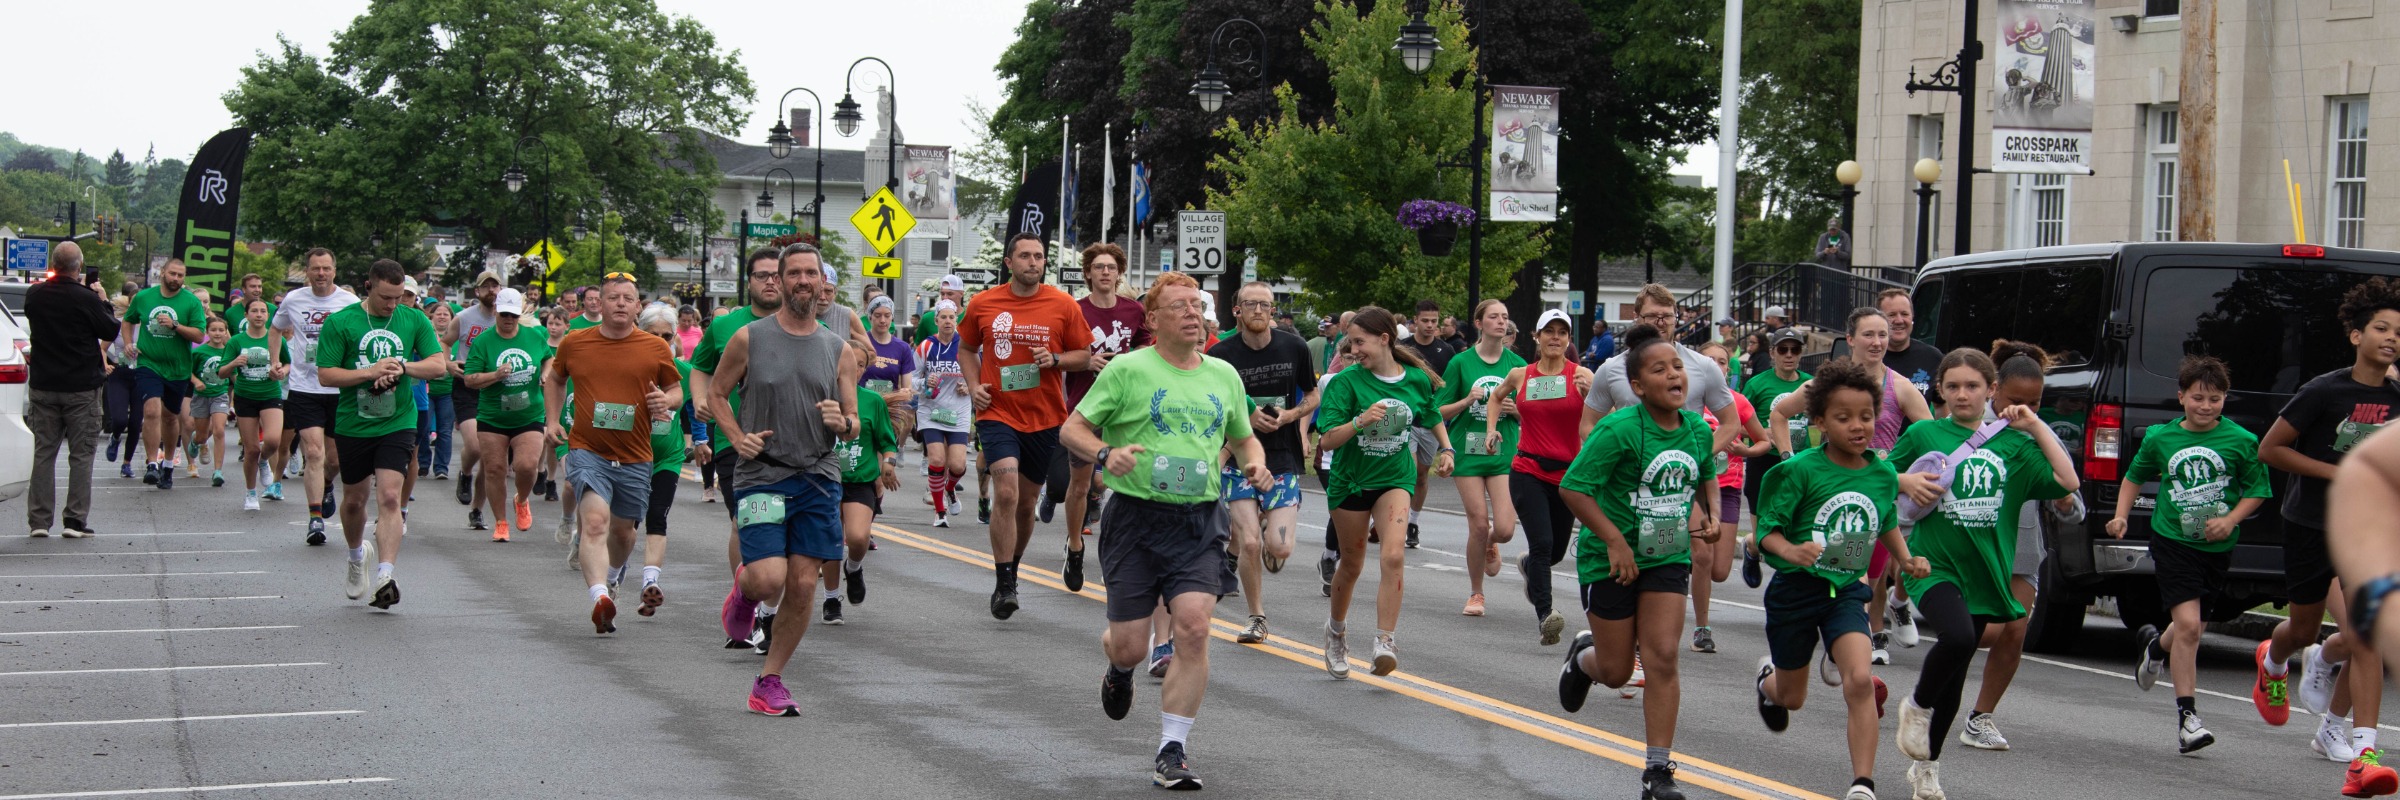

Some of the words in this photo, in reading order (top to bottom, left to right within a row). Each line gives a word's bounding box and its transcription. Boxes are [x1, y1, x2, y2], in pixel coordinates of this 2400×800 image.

[1501, 92, 1552, 105] NEWARK
[2005, 136, 2078, 152] CROSSPARK
[909, 149, 944, 158] NEWARK
[2002, 152, 2029, 161] FAMILY
[2031, 153, 2080, 163] RESTAURANT
[1507, 203, 1528, 213] Apple
[753, 225, 778, 236] Maple
[1184, 247, 1222, 269] 30
[185, 219, 231, 312] ART
[361, 331, 377, 349] LAUREL
[377, 330, 397, 340] HOUSE
[926, 361, 960, 370] BUFFA
[1249, 362, 1292, 375] EASTON
[1271, 370, 1293, 378] JACKET
[1535, 380, 1556, 392] 242
[604, 408, 625, 421] 262
[1162, 405, 1188, 414] Laurel
[1190, 407, 1215, 416] House
[2349, 403, 2390, 424] NIKE
[1180, 422, 1196, 434] 5K
[1474, 437, 1485, 448] 27
[2191, 448, 2216, 459] HOUSE
[1645, 456, 1667, 481] LAUREL
[1669, 452, 1694, 466] HOUSE
[1177, 466, 1185, 482] 3
[2193, 484, 2222, 494] ANNUAL
[2203, 491, 2225, 501] 2025
[751, 500, 768, 514] 94
[1818, 496, 1847, 523] LAUREL
[1849, 495, 1874, 514] HOUSE
[1945, 502, 1966, 510] 10TH
[1968, 499, 1999, 507] ANNUAL
[2193, 512, 2218, 530] 27
[1658, 527, 1675, 544] 55
[1844, 541, 1863, 557] 56
